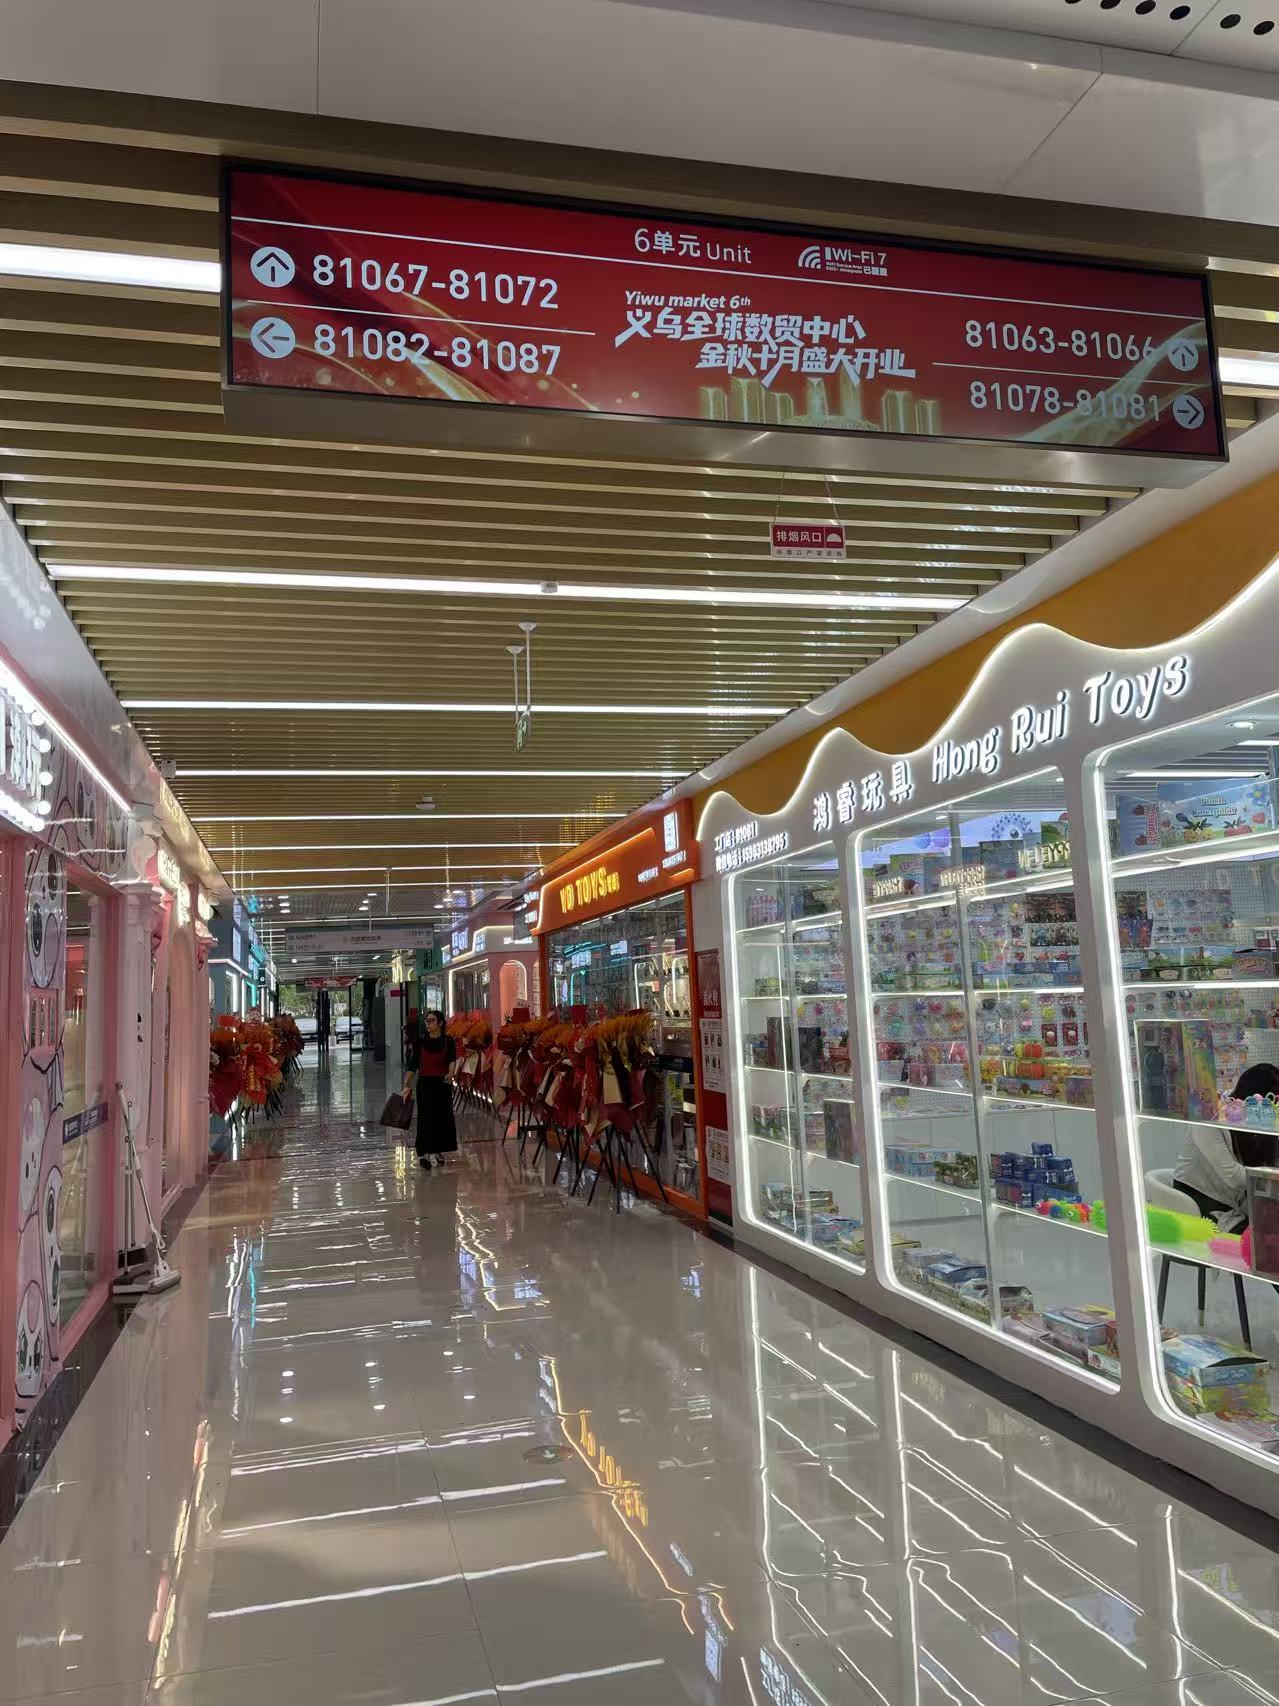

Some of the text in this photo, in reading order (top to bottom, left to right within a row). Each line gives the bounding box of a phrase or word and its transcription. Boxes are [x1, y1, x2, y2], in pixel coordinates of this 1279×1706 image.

[634, 227, 752, 264] 6单元 Unit
[832, 247, 886, 265] Wi-Fi 7
[312, 255, 559, 309] 81067-81072
[624, 291, 751, 311] Yiwu market 6th
[314, 325, 561, 376] 81082-81087
[614, 308, 867, 352] 义乌全球数贸中心
[965, 319, 1154, 361] 81063-81066
[695, 343, 916, 389] 金秋十月盛大开业
[970, 381, 1160, 422] 81078-81081
[776, 530, 822, 543] 排烟风口
[813, 655, 1188, 832] 鸿睿玩具 Hong Rui Toys
[575, 866, 607, 906] TOYS
